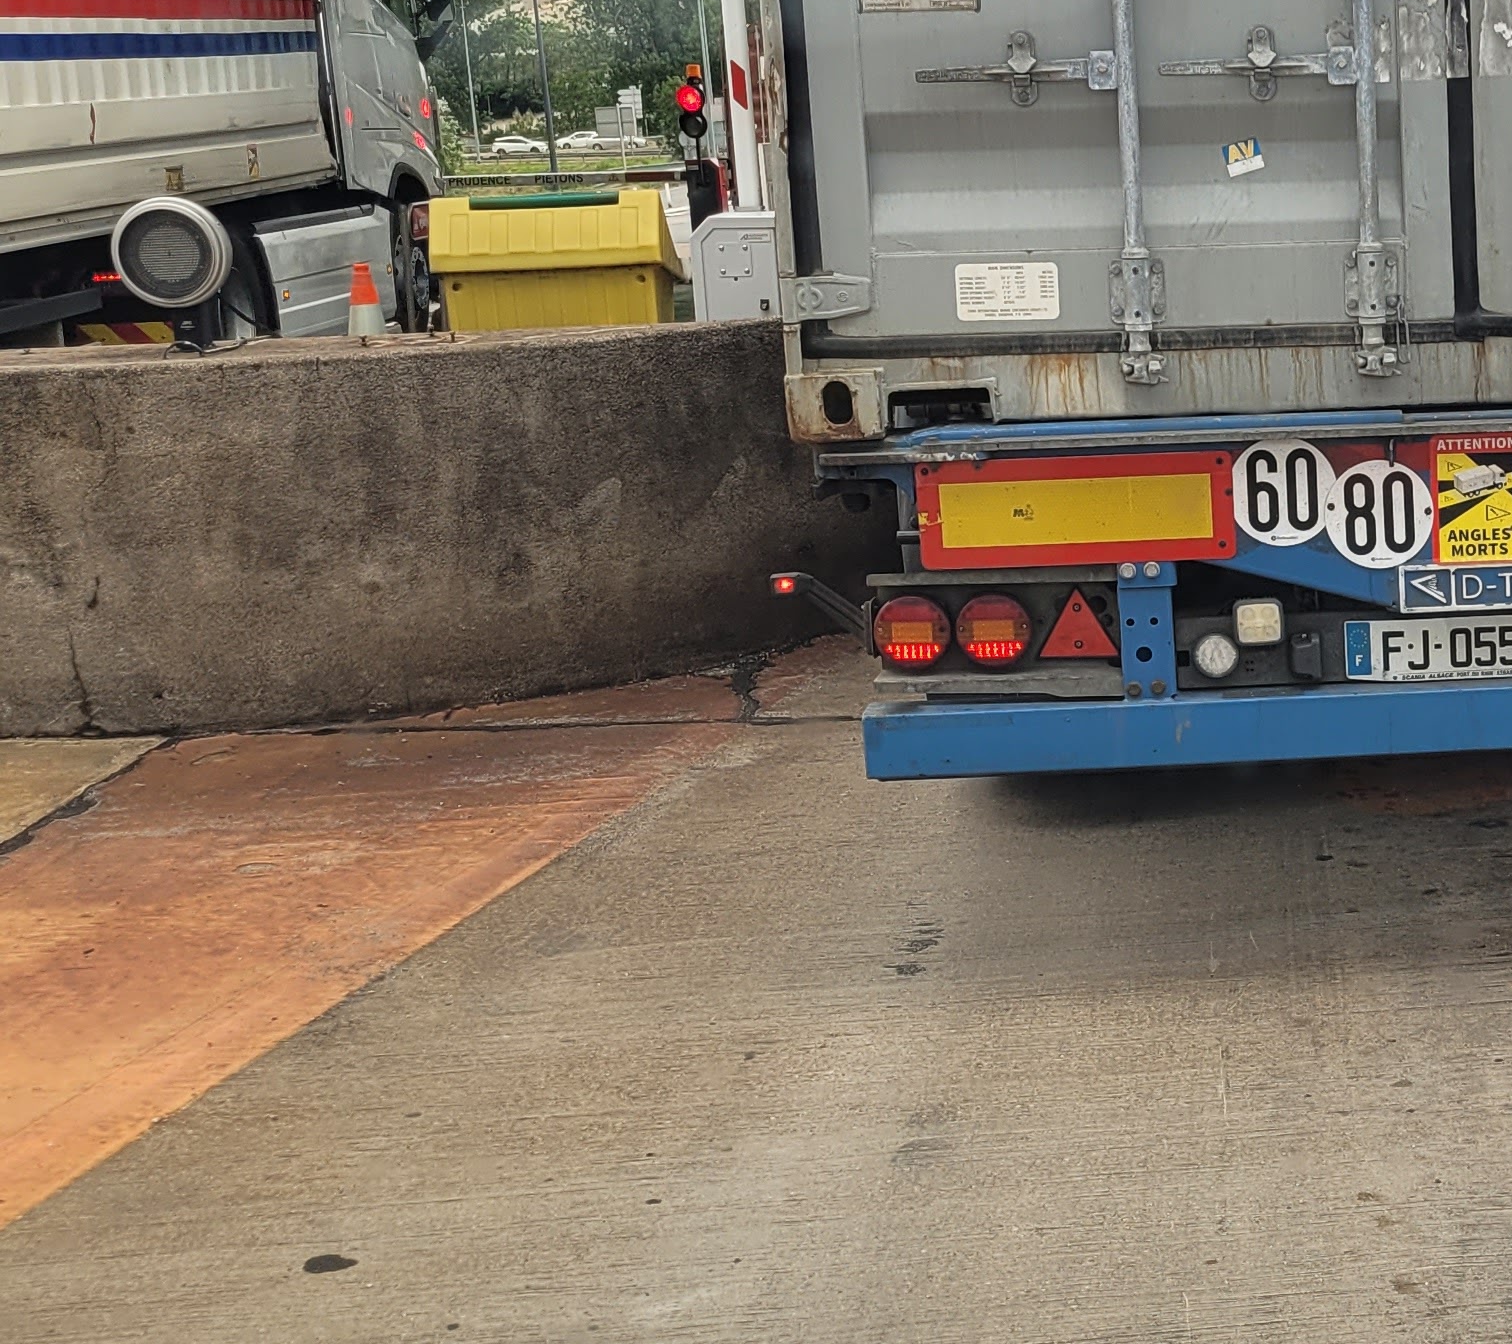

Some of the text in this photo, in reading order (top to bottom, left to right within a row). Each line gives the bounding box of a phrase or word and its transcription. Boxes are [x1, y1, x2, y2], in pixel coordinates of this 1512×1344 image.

[447, 173, 584, 187] PRUDENCE PIETONS
[1246, 447, 1319, 533] 60
[1343, 470, 1416, 556] 80
[1447, 527, 1512, 543] ANGLES
[1451, 542, 1509, 557] MORTS
[1355, 654, 1364, 667] F
